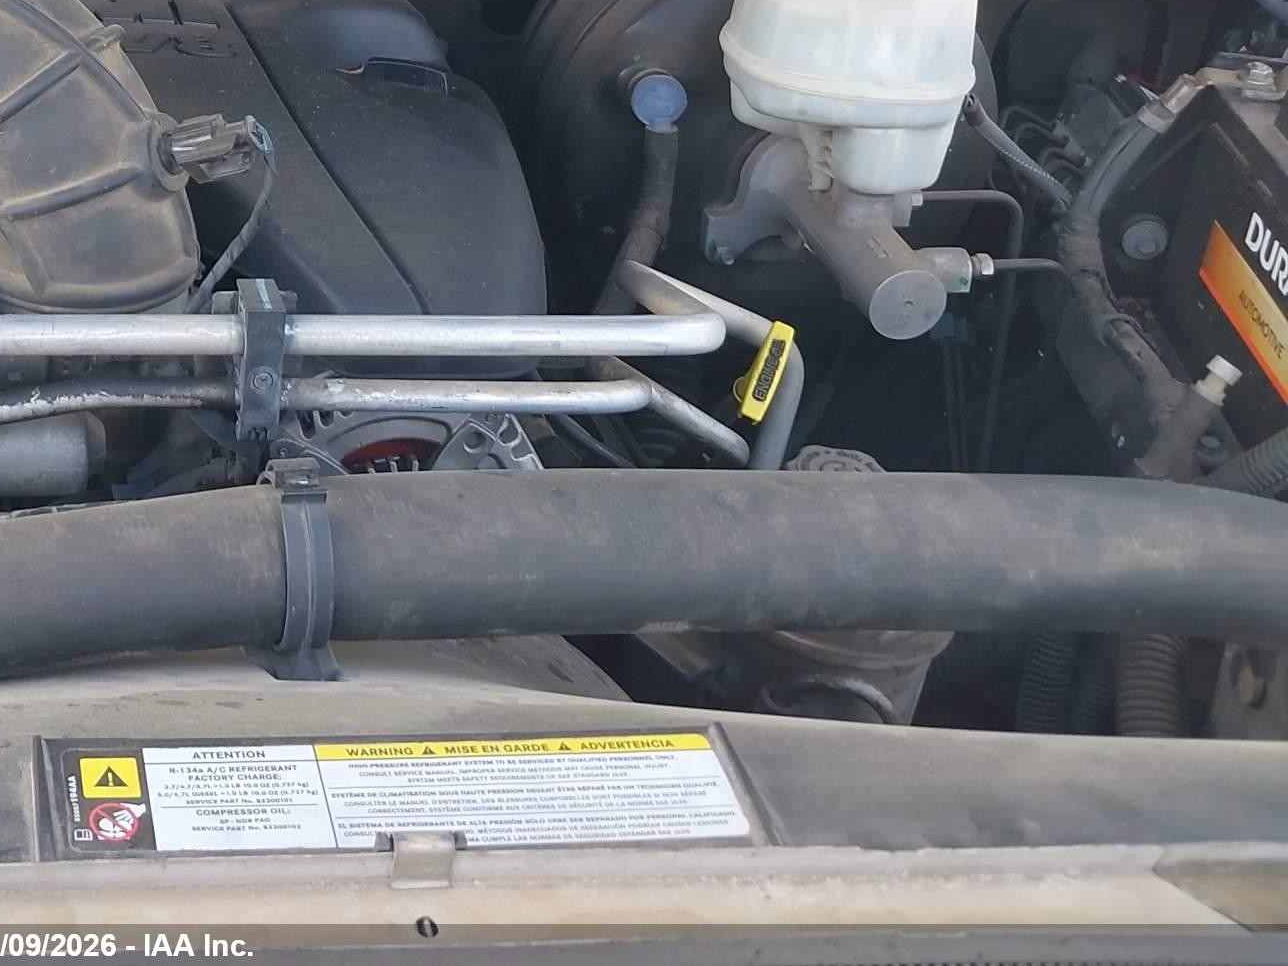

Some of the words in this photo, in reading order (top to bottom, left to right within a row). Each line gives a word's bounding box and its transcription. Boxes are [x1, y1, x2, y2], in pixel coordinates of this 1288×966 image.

[1238, 289, 1286, 360] AUTOMOTIVE
[754, 355, 779, 401] ENGINE
[445, 745, 478, 754] MISE
[482, 745, 499, 753] EN
[504, 743, 549, 753] GARDE
[580, 739, 674, 750] ADVERTENCIA
[192, 751, 266, 760] ATTENTION
[346, 746, 413, 756] WARNING
[229, 765, 297, 773] REFRIGERANT
[237, 773, 282, 781] CHARGE:
[196, 808, 267, 816] COMPRESSOR
